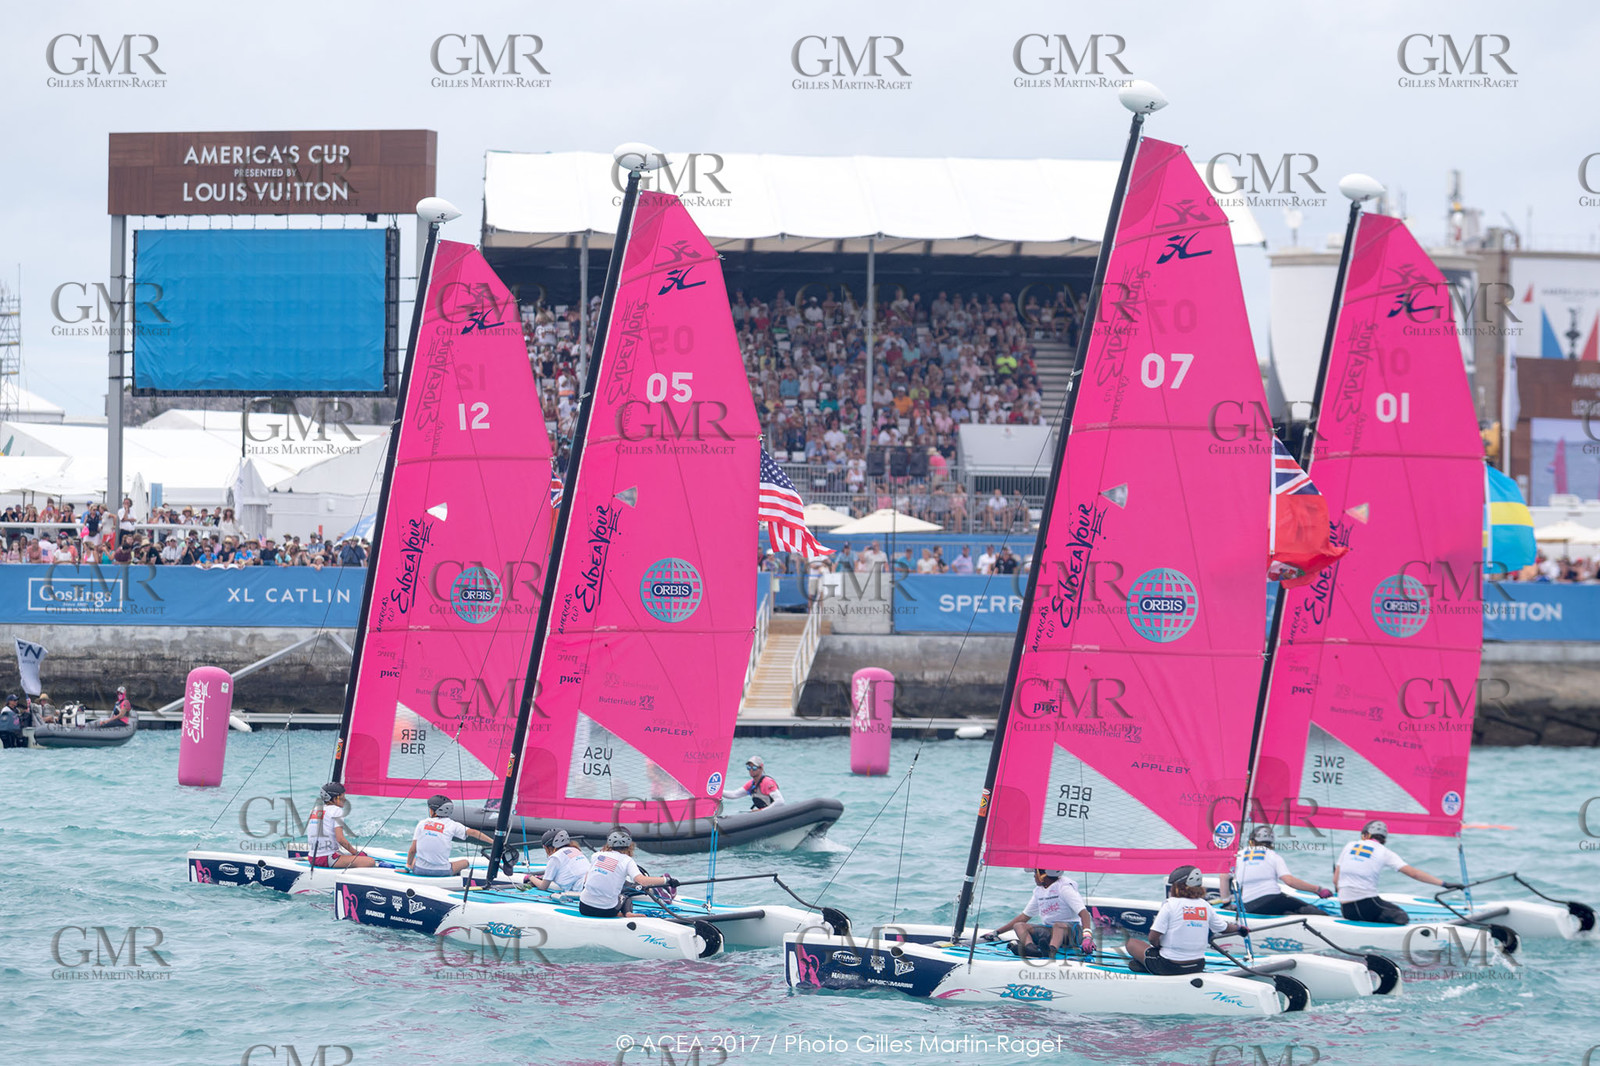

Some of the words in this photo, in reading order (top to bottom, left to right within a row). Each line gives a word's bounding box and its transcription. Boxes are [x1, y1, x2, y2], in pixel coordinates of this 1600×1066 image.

[184, 145, 300, 164] AMERICA'S
[308, 144, 350, 164] CUP
[234, 168, 283, 178] PRESENTED
[286, 168, 297, 177] BY
[183, 182, 247, 202] LOUIS
[254, 182, 348, 201] VUITTON
[1141, 352, 1194, 389] 07
[646, 372, 693, 403] 05
[1376, 392, 1409, 423] 01
[458, 402, 490, 430] 12
[39, 584, 112, 607] Goslings
[228, 588, 254, 602] XL
[265, 588, 350, 603] CATLIN
[462, 590, 492, 600] ORBIS
[653, 585, 690, 595] ORBIS
[939, 594, 1024, 613] SPERR
[1143, 599, 1183, 611] ORBIS
[1384, 601, 1418, 612] ORBIS
[1484, 602, 1563, 621] UITTON
[380, 669, 400, 678] pwc
[559, 674, 582, 684] pwc
[1291, 683, 1313, 695] pwc
[1033, 700, 1059, 713] pwc
[644, 726, 694, 736] APPLEBY
[401, 743, 426, 755] BER
[1373, 737, 1423, 749] APPLEBY
[582, 764, 612, 777] USA
[1131, 761, 1191, 774] APPLEBY
[1312, 771, 1343, 785] SWE
[1057, 802, 1090, 820] BER
